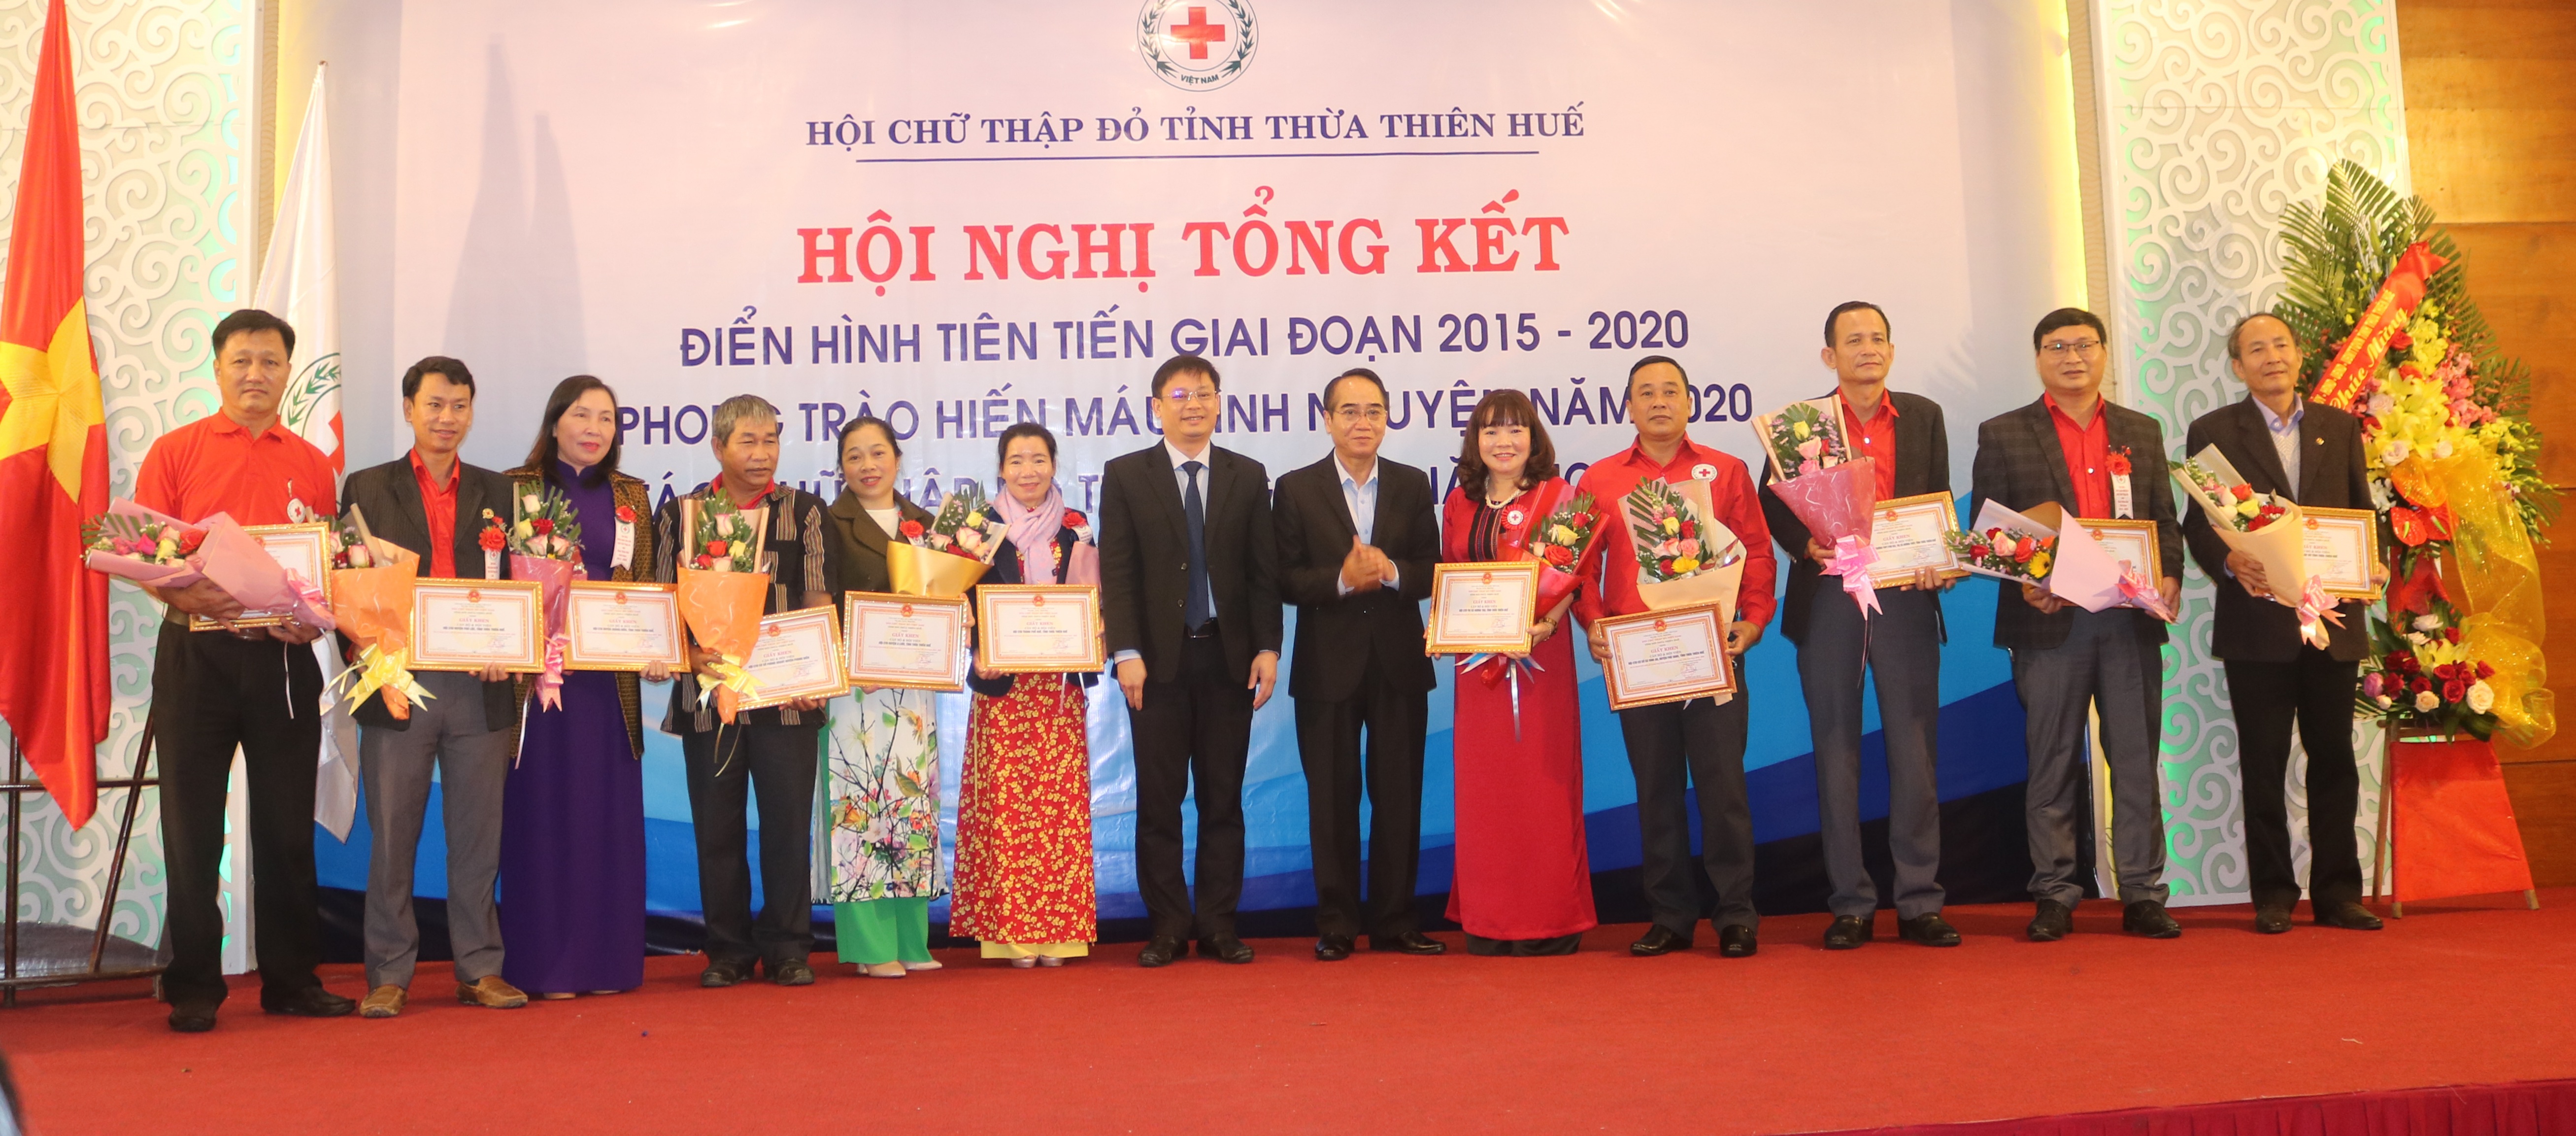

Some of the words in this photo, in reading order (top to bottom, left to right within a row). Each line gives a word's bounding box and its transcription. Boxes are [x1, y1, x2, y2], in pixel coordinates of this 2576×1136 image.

[1181, 74, 1200, 85] VIỆT
[1201, 74, 1219, 84] NAM
[805, 114, 875, 151] HỘI
[888, 113, 970, 144] CHỮ
[981, 111, 1083, 149] THẬP
[1096, 106, 1149, 141] ĐỎ
[1161, 106, 1253, 141] TỈNH
[1266, 107, 1369, 139] THỪA
[1380, 106, 1496, 138] THIÊN
[1507, 101, 1585, 137] HUẾ
[797, 209, 936, 297] HỘI
[963, 223, 1156, 293] NGHỊ
[1182, 186, 1389, 277] TỔNG
[1415, 189, 1569, 273] KẾT
[680, 306, 793, 367] ĐIỂN
[812, 313, 920, 364] HÌNH
[937, 312, 1036, 362] TIÊN
[1053, 304, 1153, 360] TIẾN
[1171, 318, 1268, 357] GIAI
[1288, 315, 1422, 362] ĐOẠN
[1438, 313, 1540, 352] 2015
[1588, 310, 1689, 349] 2020
[2367, 307, 2407, 367] Mừng
[618, 405, 784, 445] PHO
[936, 382, 1046, 439] HIẾN
[1308, 379, 1495, 437] NUYỆ
[1530, 377, 1635, 425] NĂM
